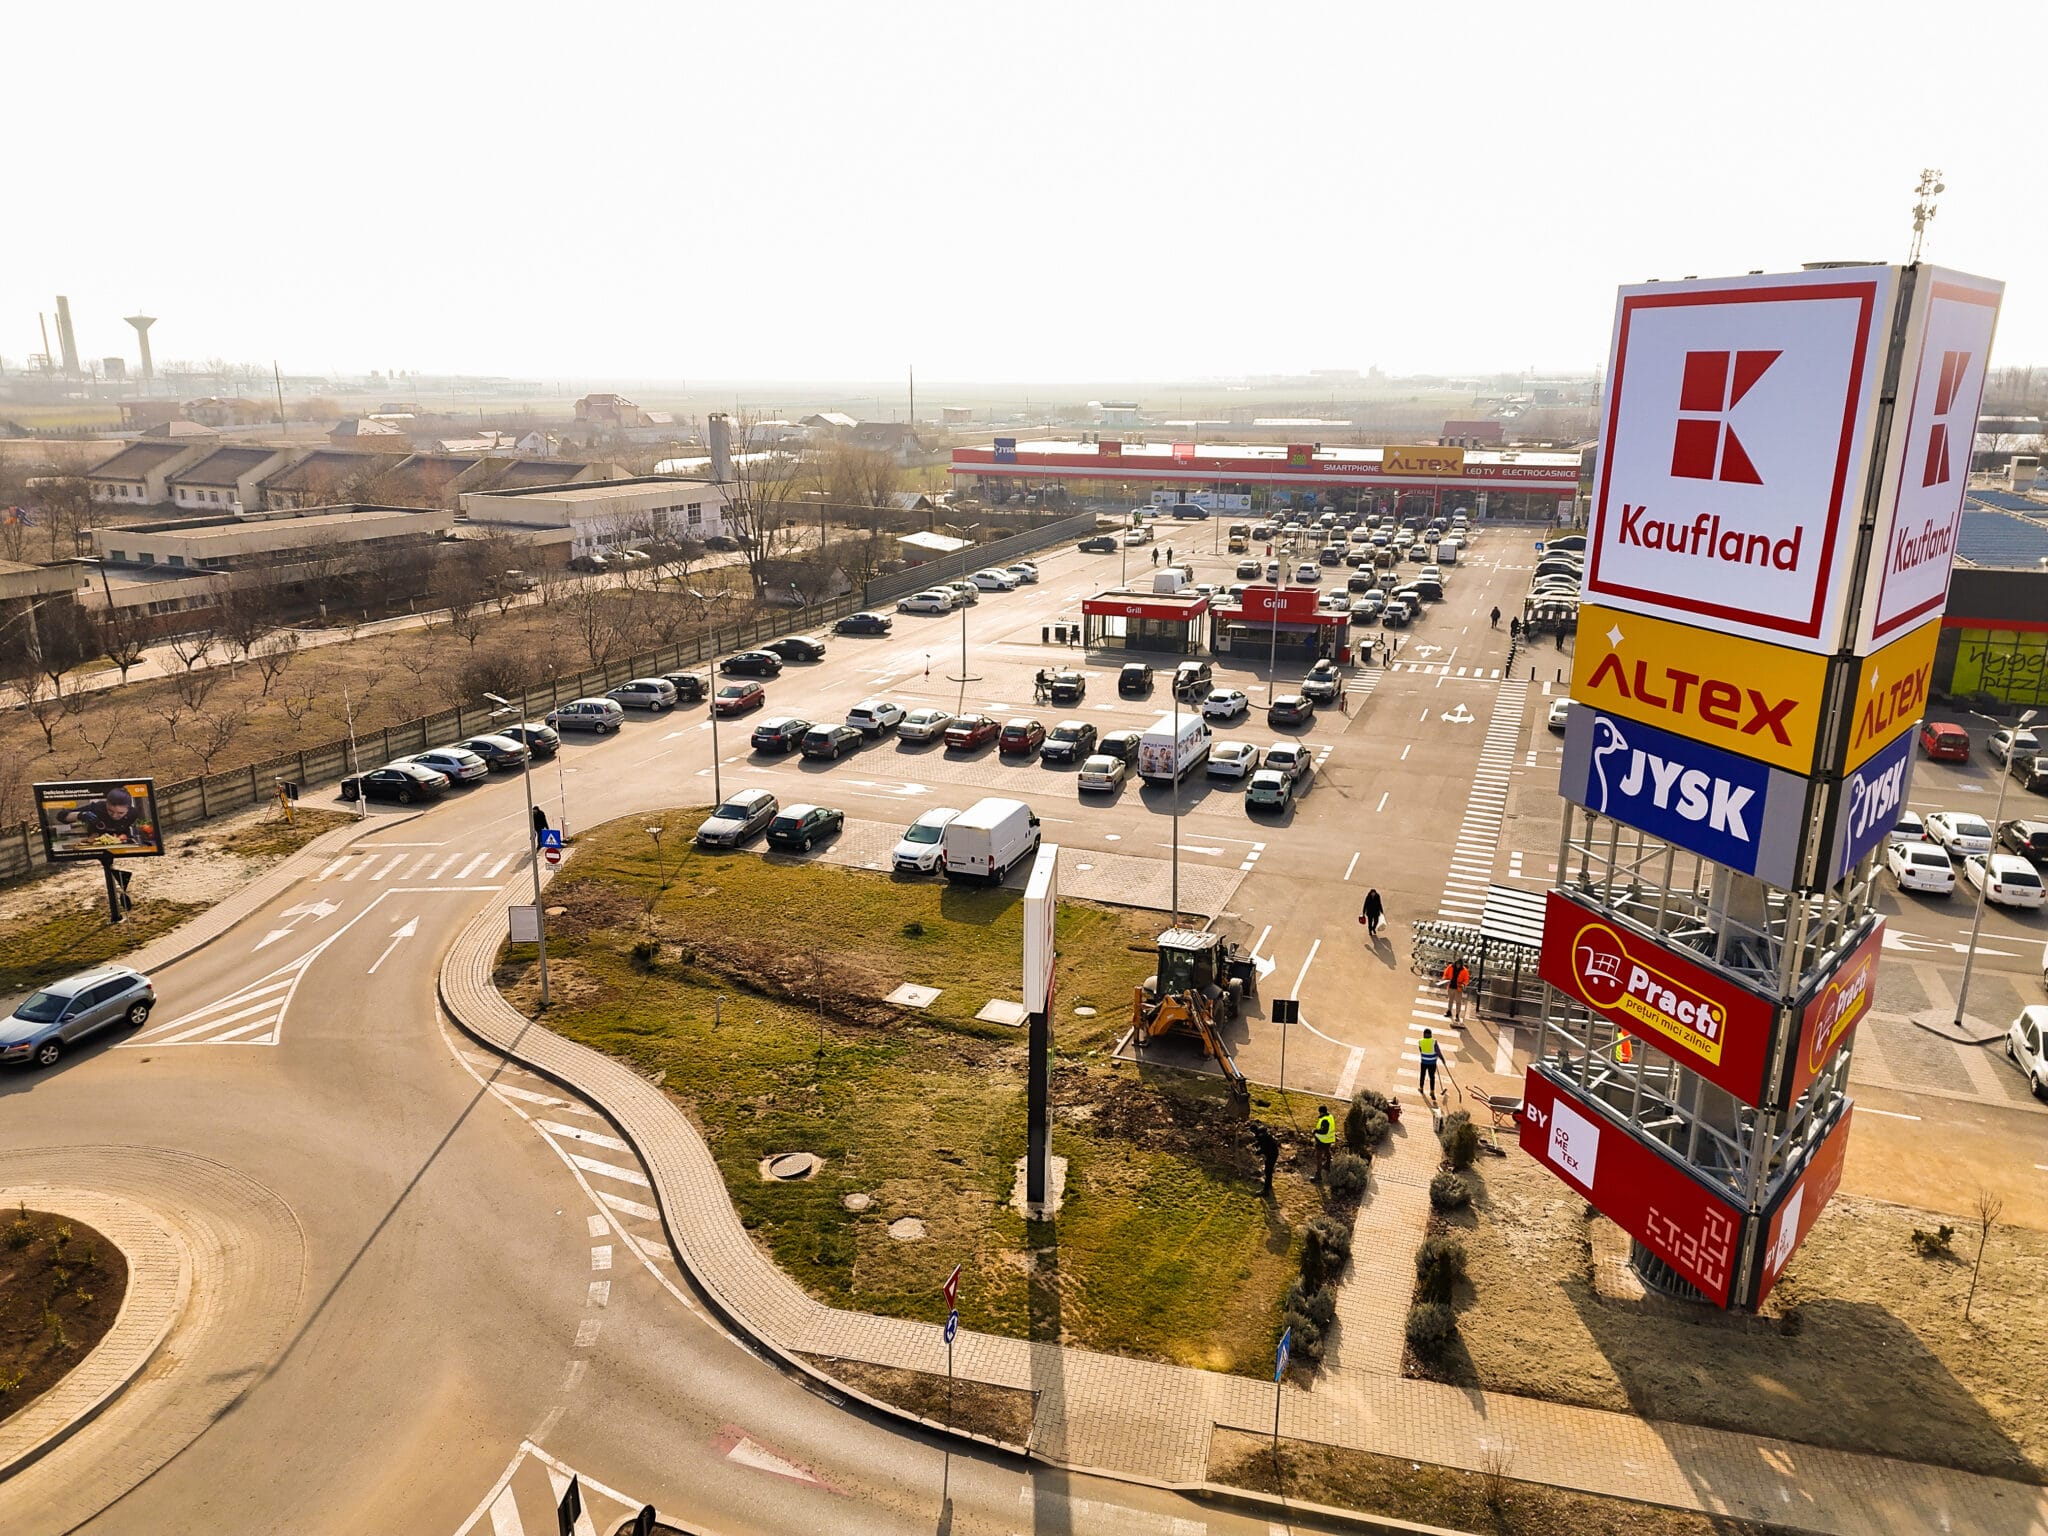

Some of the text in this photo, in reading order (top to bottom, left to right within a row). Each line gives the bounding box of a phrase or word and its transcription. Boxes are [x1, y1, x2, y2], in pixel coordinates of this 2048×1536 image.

[1323, 463, 1379, 472] SMARTPHONE
[1502, 468, 1576, 478] ELECTROCASNICE
[1619, 504, 1803, 572] Kaufland
[1892, 511, 1954, 576] Kaufland
[1126, 606, 1142, 614] Grill
[1263, 598, 1288, 609] Grill
[1619, 749, 1756, 842] JYSK
[1856, 755, 1907, 839] JYSK
[1627, 965, 1721, 1039] Practi
[1834, 961, 1871, 1022] Practi
[1661, 1019, 1682, 1036] mici
[1684, 1031, 1712, 1053] zilnic
[1527, 1103, 1548, 1128] BY
[1555, 1136, 1568, 1152] ME
[1556, 1128, 1569, 1142] CO
[1562, 1151, 1579, 1170] TEX
[1764, 1241, 1778, 1271] BY
